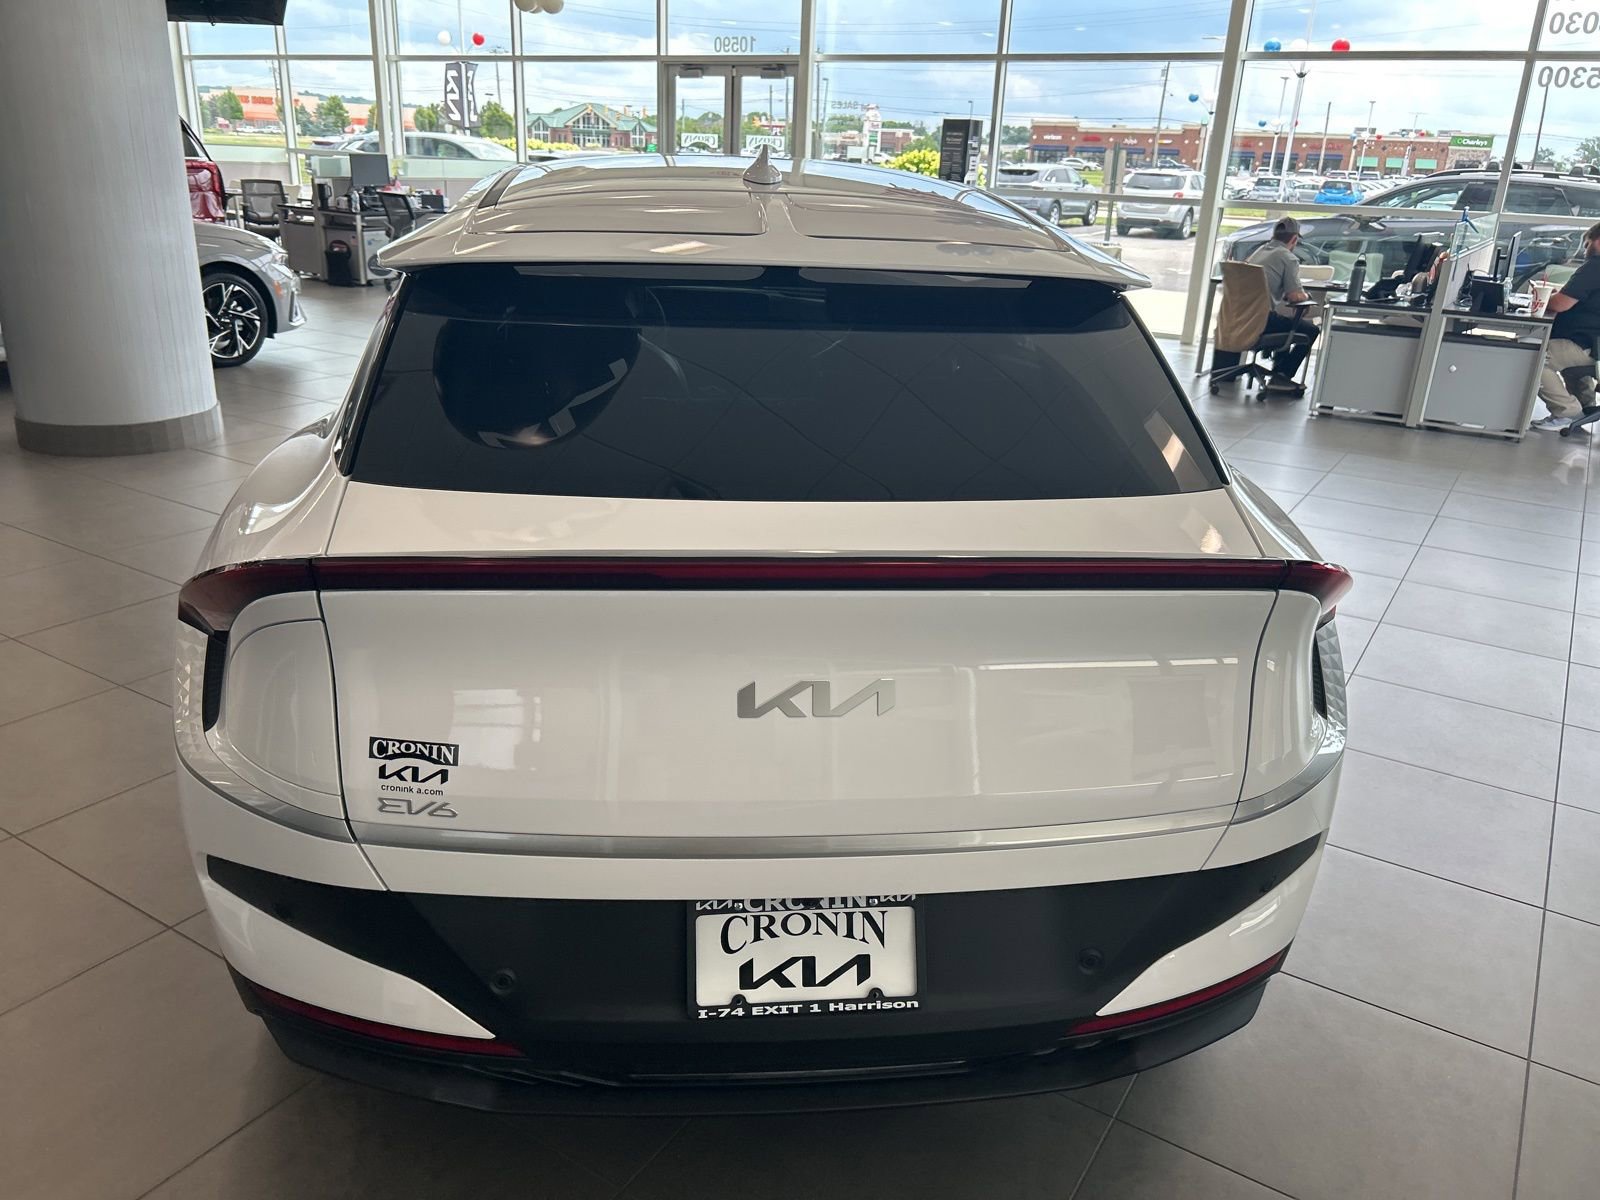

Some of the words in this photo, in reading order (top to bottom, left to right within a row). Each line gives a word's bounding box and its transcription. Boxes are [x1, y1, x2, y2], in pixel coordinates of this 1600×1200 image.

[737, 678, 896, 719] KIA
[372, 739, 456, 765] CRONIN
[378, 763, 449, 785] KIA
[377, 797, 458, 818] EV6
[720, 910, 888, 955] CRONIN
[738, 953, 871, 991] KIA
[698, 1007, 745, 1019] I-74
[752, 1004, 803, 1016] EXIT
[809, 1003, 822, 1014] 1
[829, 1000, 919, 1012] Harrison
